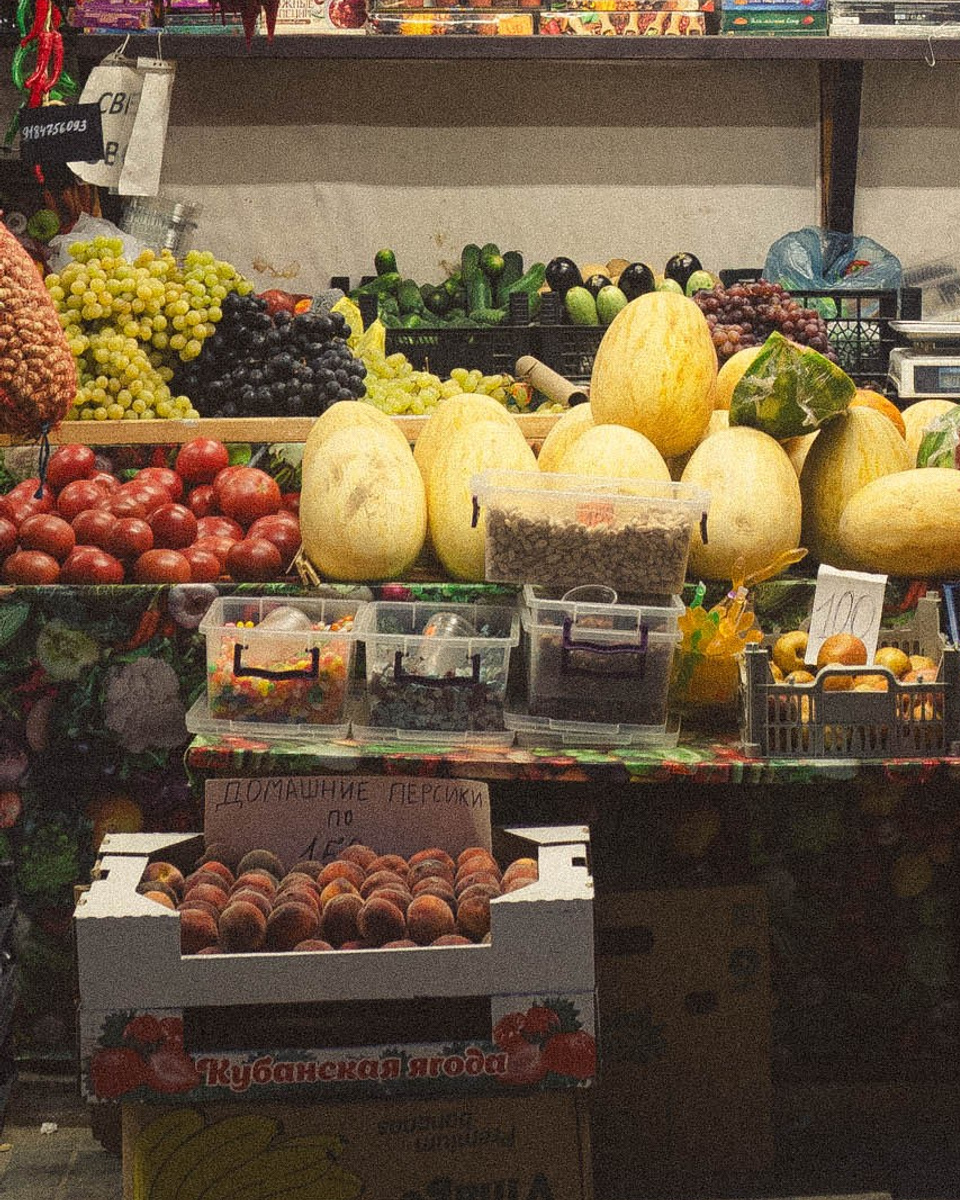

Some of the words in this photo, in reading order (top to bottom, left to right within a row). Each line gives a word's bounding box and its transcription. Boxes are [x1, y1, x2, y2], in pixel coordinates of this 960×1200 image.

[281, 0, 314, 9] ЖНЫЕ
[815, 590, 876, 639] 100
[215, 779, 370, 812] ДОМАШНИЕ
[388, 782, 484, 809] ПЕРСИКИ
[197, 1054, 401, 1093] Кубанская
[408, 1046, 509, 1080] ягода
